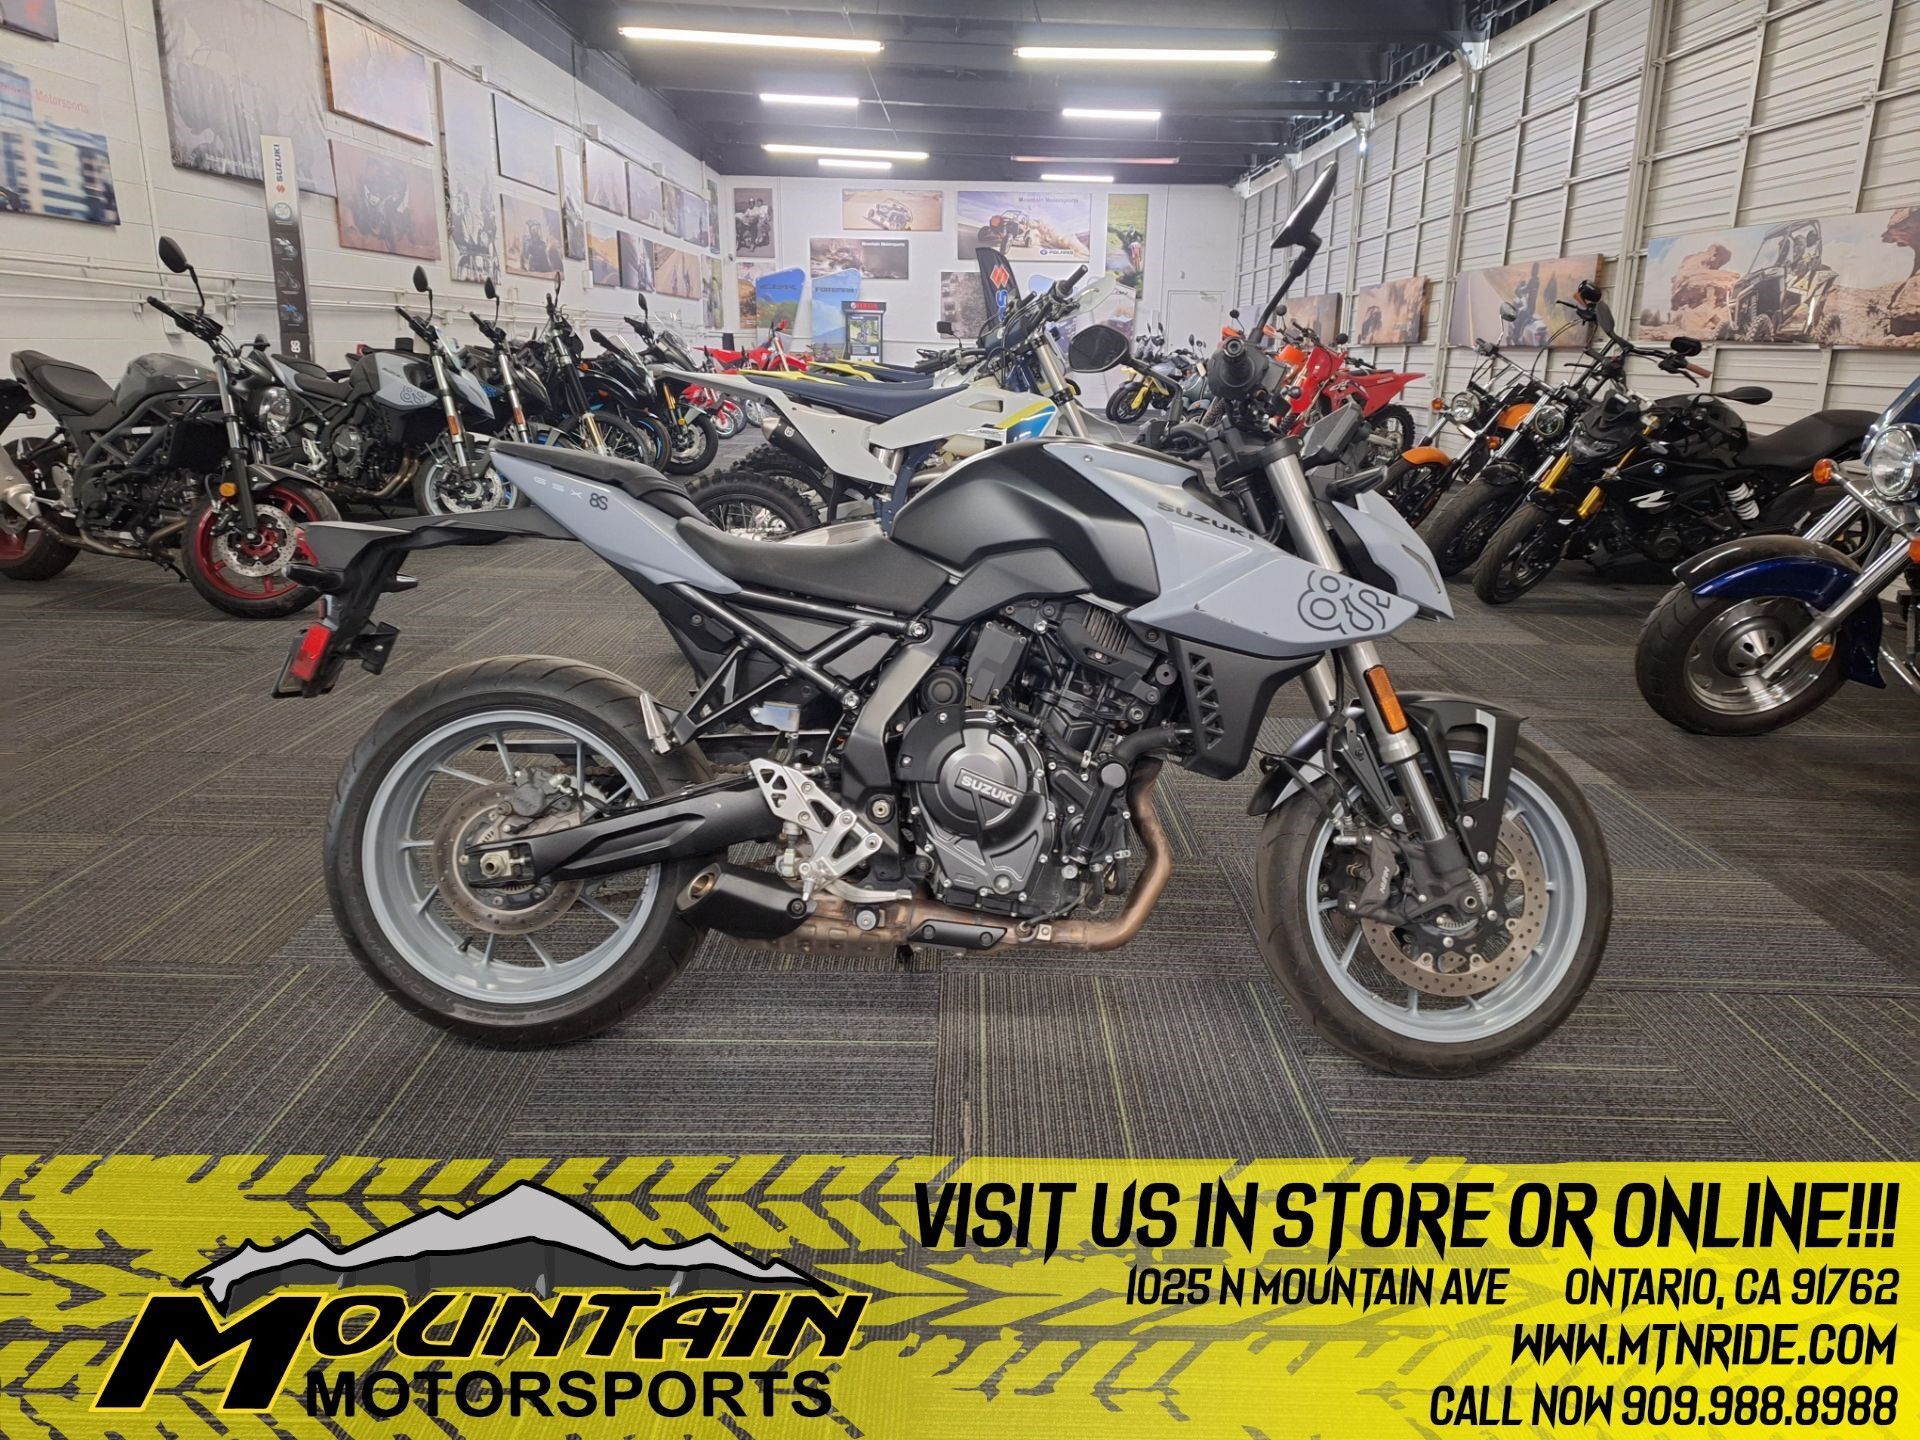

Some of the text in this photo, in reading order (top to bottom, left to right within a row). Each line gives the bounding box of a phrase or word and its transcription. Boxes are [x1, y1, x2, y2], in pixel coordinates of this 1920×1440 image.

[273, 144, 283, 182] SUZUKI
[589, 492, 609, 511] 8S
[1156, 501, 1255, 541] SUZUKI
[960, 774, 1018, 805] SUZUKI
